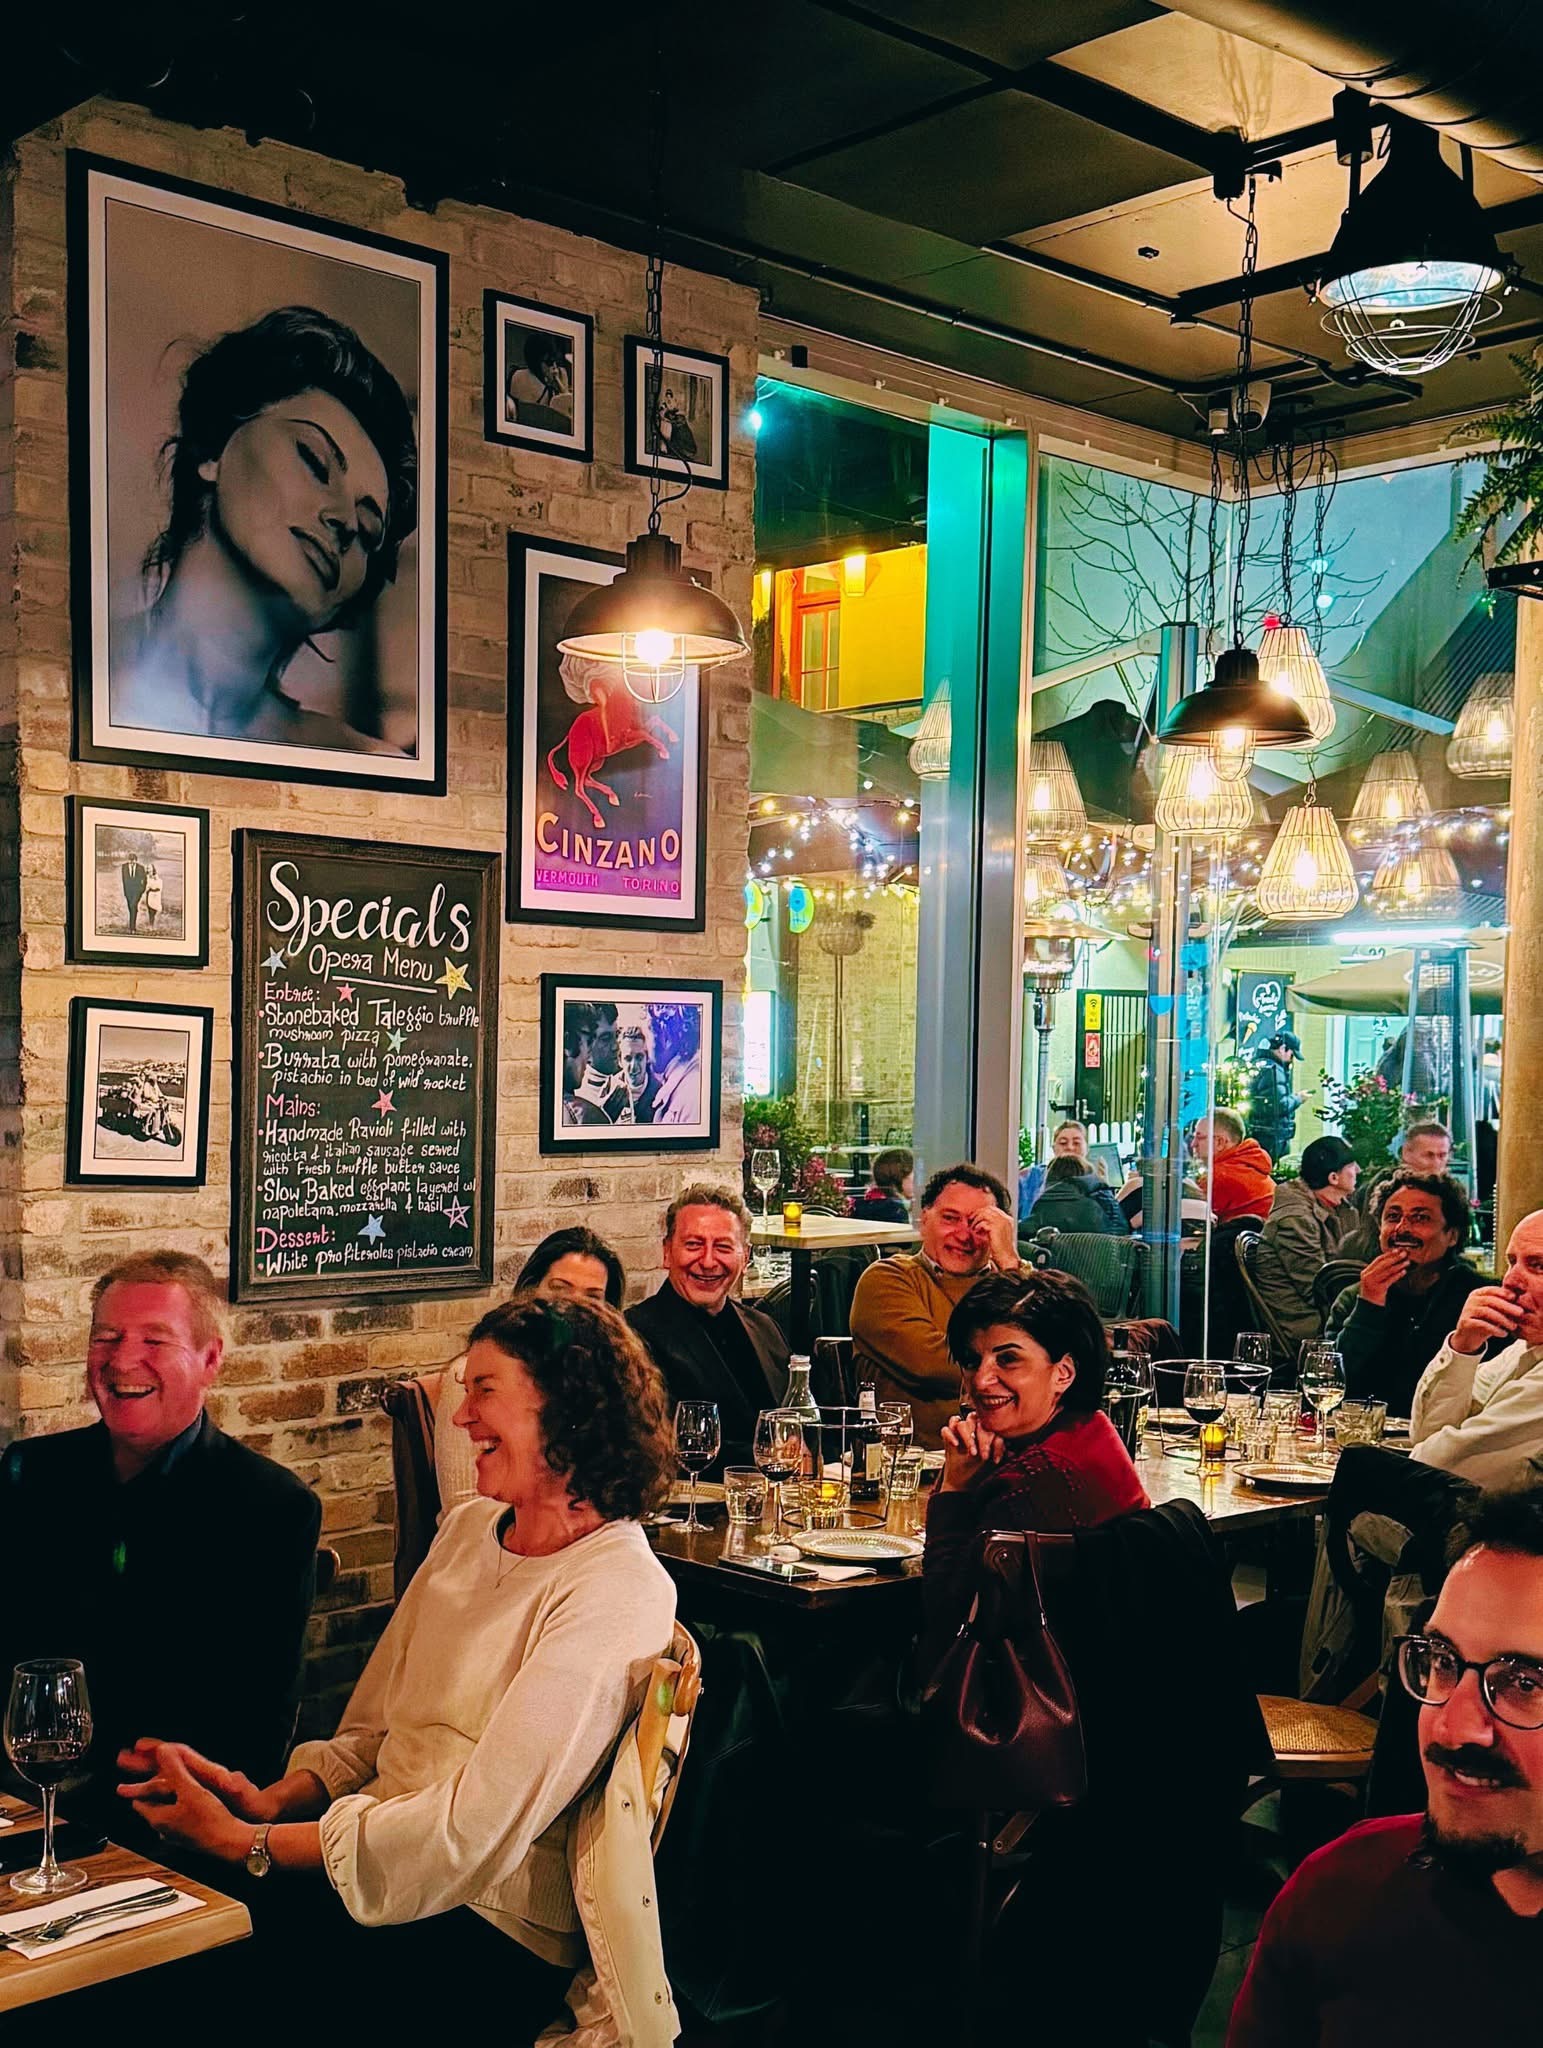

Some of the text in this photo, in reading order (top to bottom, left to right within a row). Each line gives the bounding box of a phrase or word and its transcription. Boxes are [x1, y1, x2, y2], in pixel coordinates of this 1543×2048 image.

[537, 812, 680, 869] CINZANO
[536, 869, 679, 893] VERMOUTH TORINO
[267, 861, 471, 957] Specials
[309, 944, 433, 984] Opera Menu
[265, 997, 480, 1032] Stonebaked Taleggio truffle
[269, 1026, 380, 1051] mushroom pizza
[262, 1043, 341, 1069] Burrata
[347, 1048, 377, 1069] with
[271, 1067, 467, 1093] pistachio in bed of wild rocket
[265, 1093, 321, 1118] Mains:
[265, 1116, 467, 1146] Handmade Ravioli filled with
[262, 1138, 460, 1164] ricotta & italian sausage served
[263, 1163, 289, 1176] with
[336, 1157, 378, 1176] truffle
[384, 1157, 425, 1175] butter
[428, 1161, 460, 1175] sauce
[263, 1177, 300, 1202] Slow
[301, 1175, 355, 1204] Baked
[360, 1175, 411, 1201] eggplant
[416, 1175, 459, 1201] layered
[404, 1192, 414, 1215] &
[417, 1194, 443, 1213] basil
[256, 1223, 336, 1253] Dessert:
[266, 1250, 308, 1277] White
[441, 1246, 474, 1258] cream
